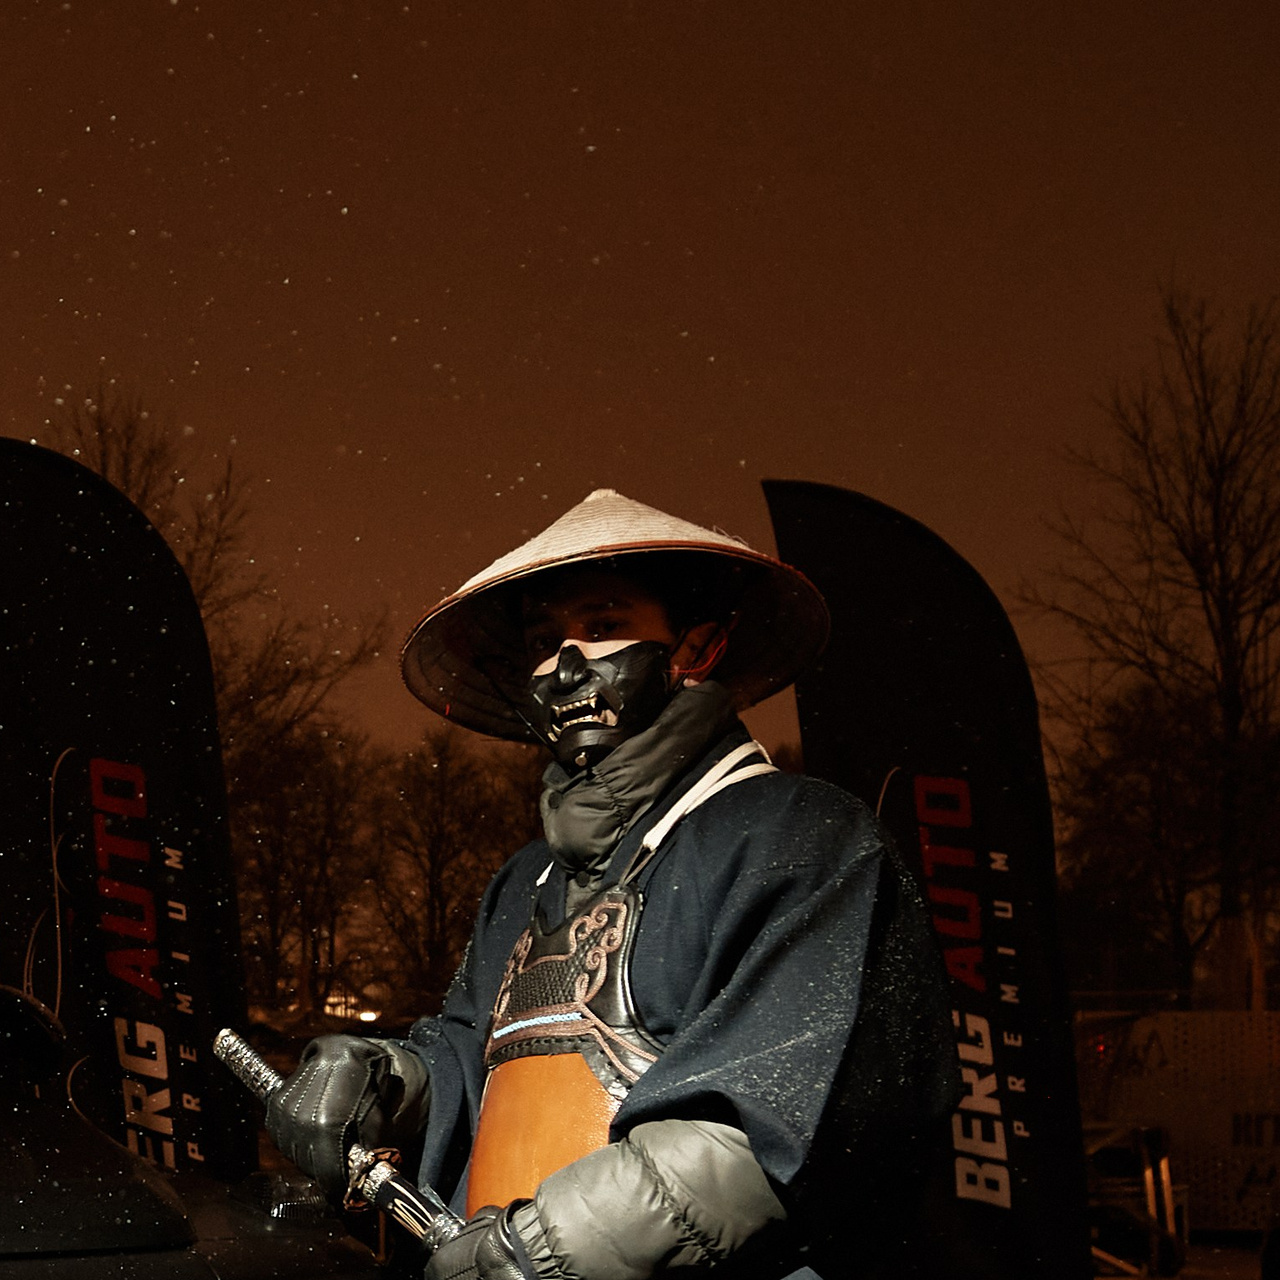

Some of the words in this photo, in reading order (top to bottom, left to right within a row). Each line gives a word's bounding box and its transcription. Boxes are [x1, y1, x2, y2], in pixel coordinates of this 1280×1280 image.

[89, 757, 163, 1000] AUTO
[913, 775, 988, 993] AUTO
[988, 851, 1031, 1138] PREMIUM
[113, 1016, 177, 1170] ERG
[163, 846, 206, 1163] PREMIUM
